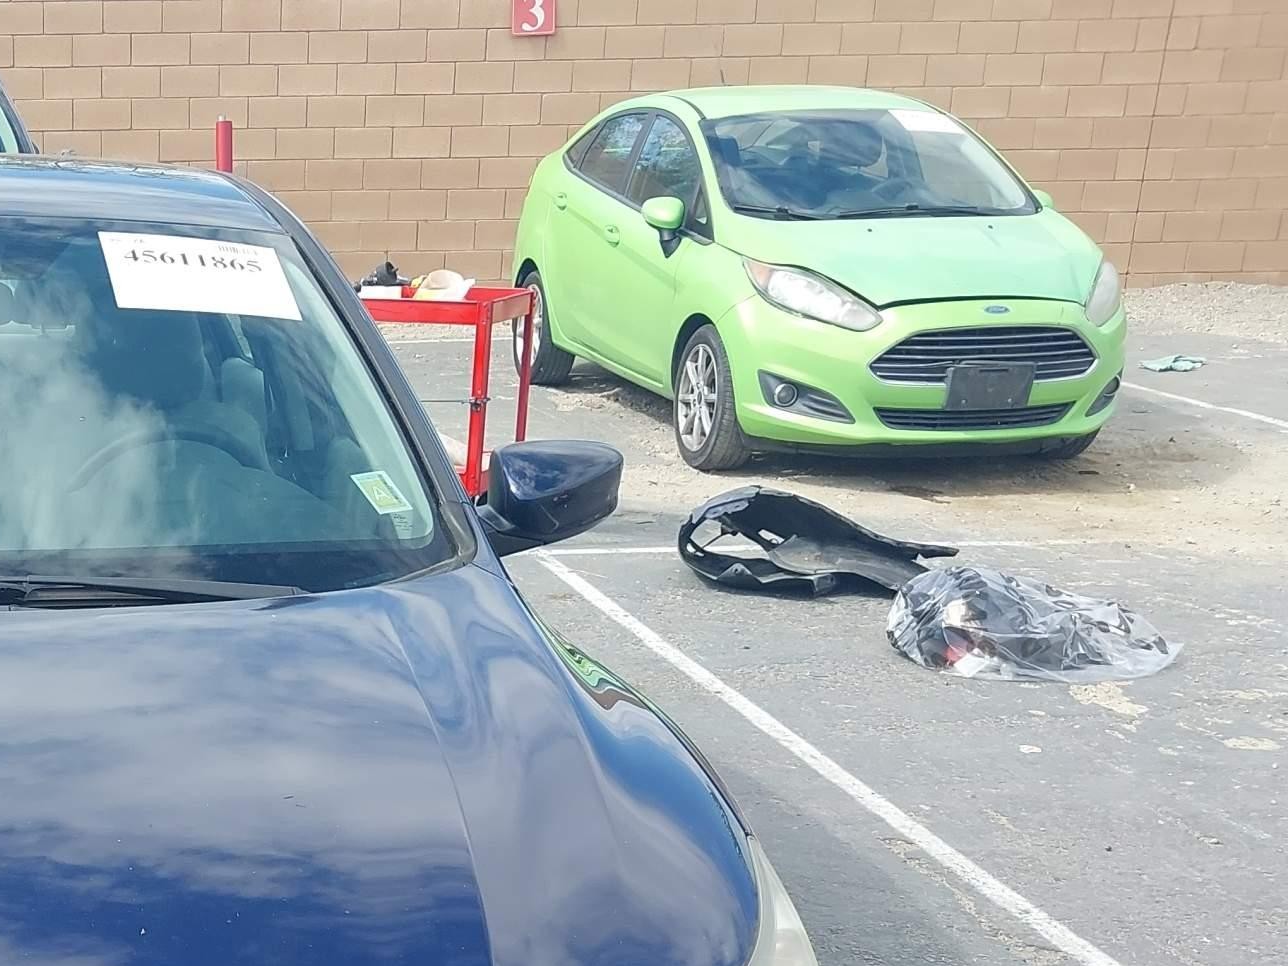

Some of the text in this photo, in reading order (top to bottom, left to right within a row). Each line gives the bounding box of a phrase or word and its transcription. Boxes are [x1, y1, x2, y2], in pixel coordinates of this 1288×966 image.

[521, 0, 545, 32] 3
[123, 248, 263, 273] 45611865
[372, 486, 391, 501] A
